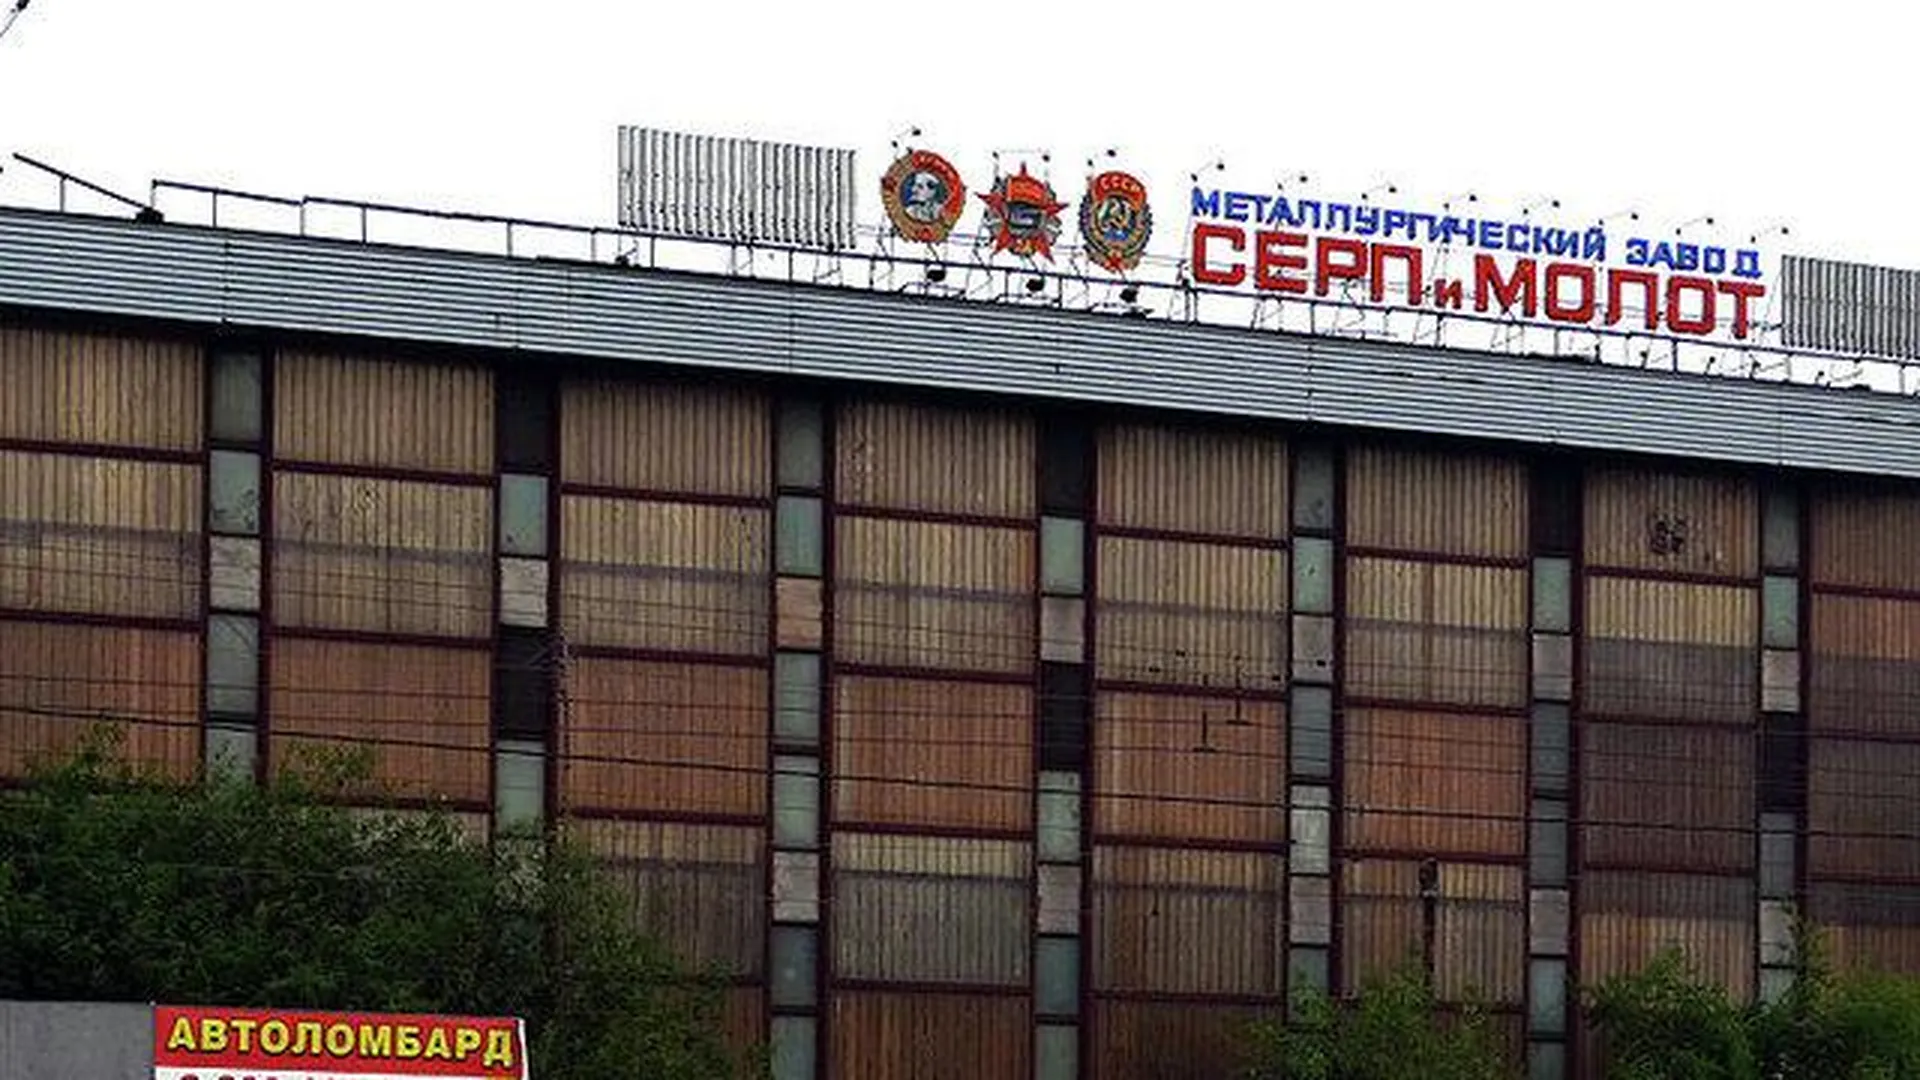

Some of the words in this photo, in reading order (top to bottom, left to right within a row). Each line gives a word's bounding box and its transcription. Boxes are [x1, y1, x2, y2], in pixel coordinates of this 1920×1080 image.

[1190, 185, 1606, 262] МЕТАЛЛУРГИЧЕСКИЙ
[1626, 237, 1763, 278] ЗАВОД
[1191, 222, 1423, 306] СЕРП
[1473, 252, 1766, 340] МОЛОТ
[167, 1015, 514, 1067] АВТОЛОМБАРД
